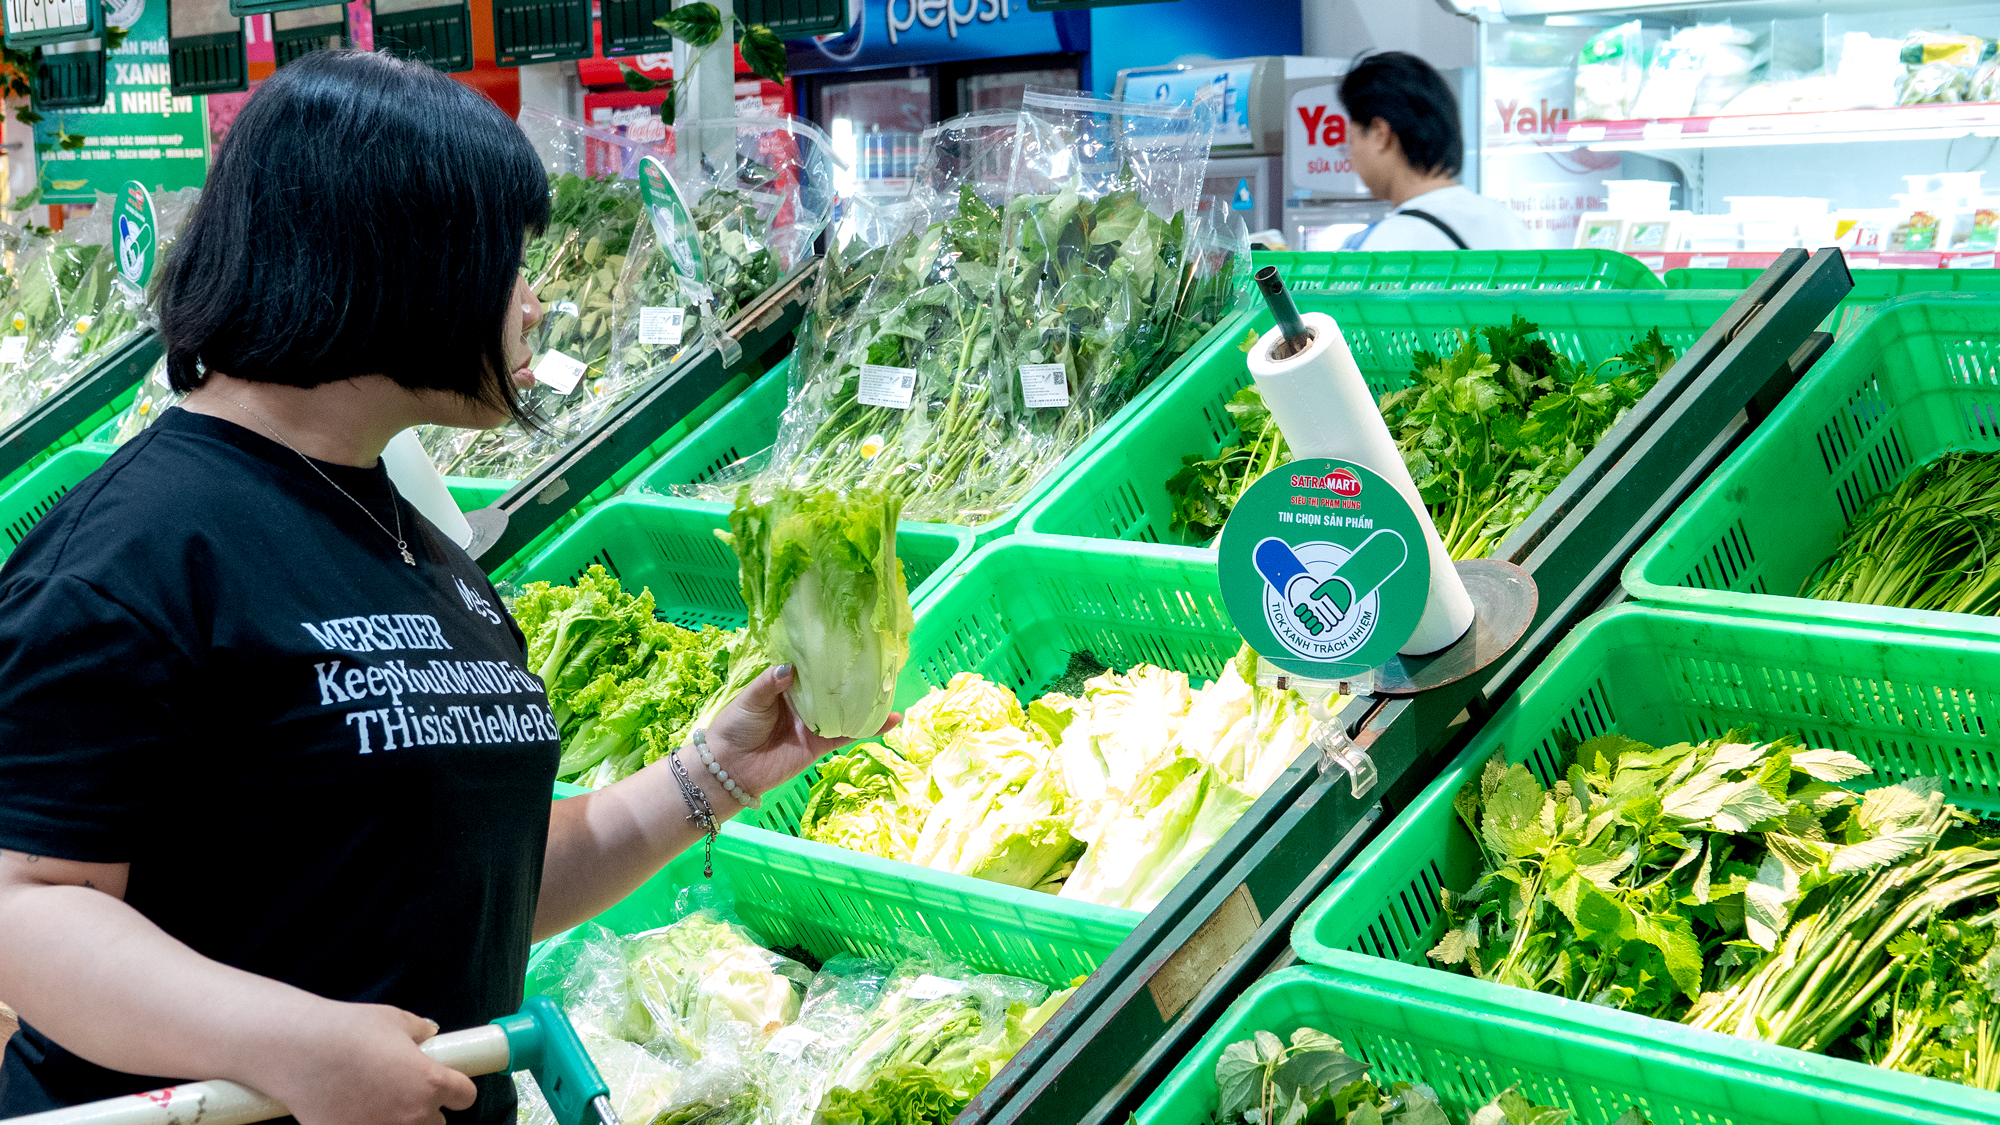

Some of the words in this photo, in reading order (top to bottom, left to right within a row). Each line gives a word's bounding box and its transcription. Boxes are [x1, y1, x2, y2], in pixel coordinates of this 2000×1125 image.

[140, 35, 169, 55] PHẨ
[115, 63, 171, 85] XANH
[121, 86, 192, 118] NHIỆM
[1494, 98, 1569, 134] Yak
[135, 135, 158, 145] DOANH
[1291, 474, 1357, 491] SATRAMART
[1291, 495, 1306, 505] SIÊU
[1308, 497, 1319, 508] THỊ
[1321, 498, 1340, 509] PHẠM
[1342, 497, 1361, 510] HÙNG
[1278, 512, 1294, 523] TIN
[1295, 513, 1321, 527] CHỌN
[1324, 512, 1343, 527] SẢN
[1345, 514, 1373, 530] PHẨM
[301, 614, 453, 652] MERSHIER
[1272, 602, 1285, 627] TICK
[1283, 627, 1310, 651] XANH
[1313, 638, 1349, 653] TRÁCH
[1348, 610, 1372, 645] NHIỆM
